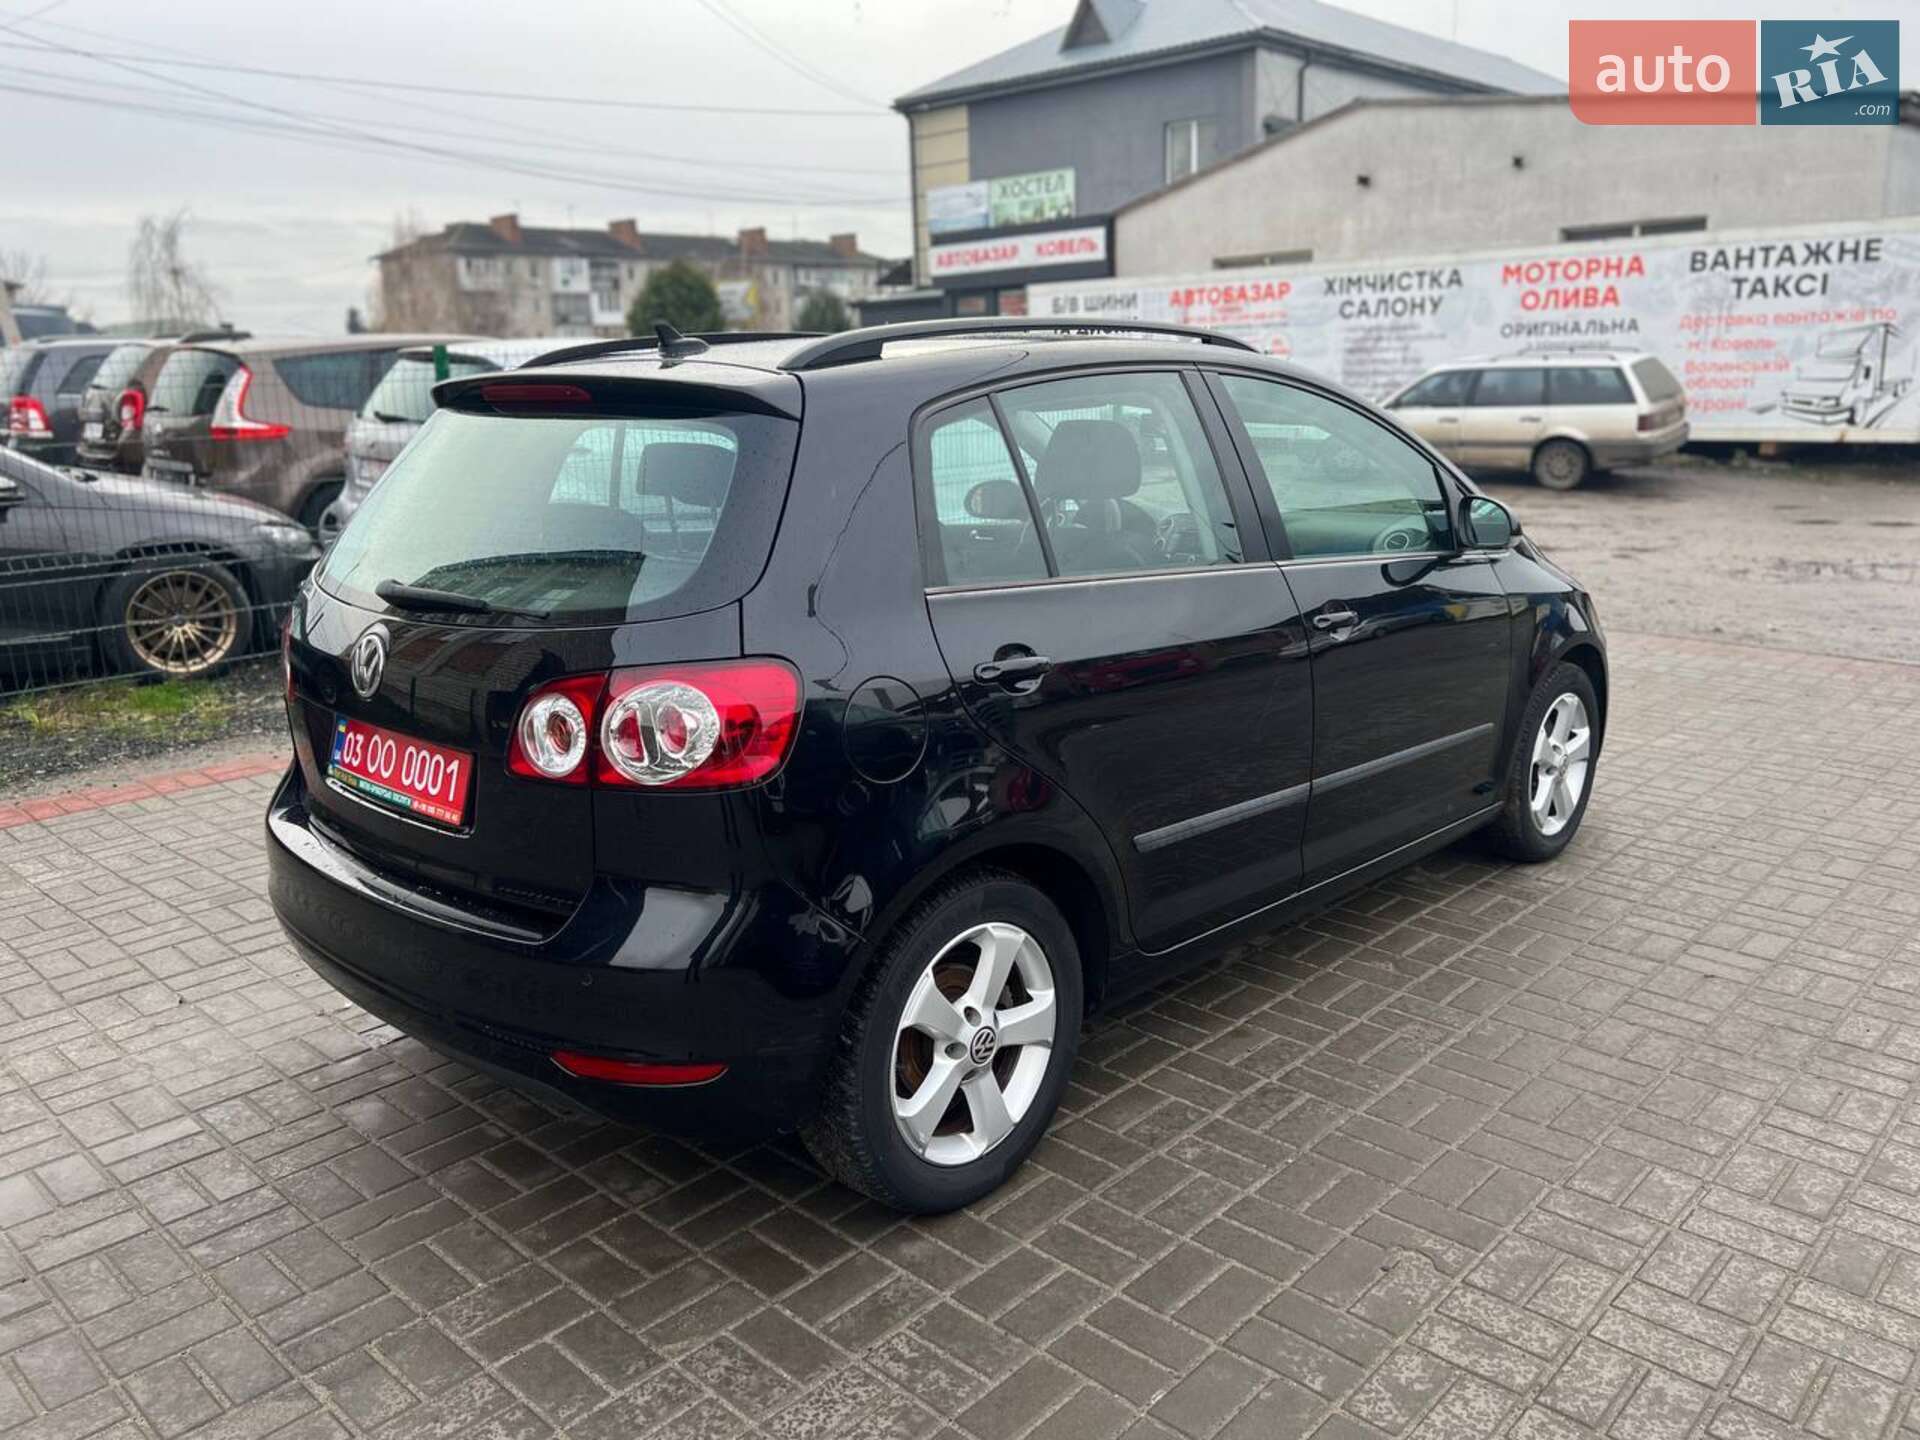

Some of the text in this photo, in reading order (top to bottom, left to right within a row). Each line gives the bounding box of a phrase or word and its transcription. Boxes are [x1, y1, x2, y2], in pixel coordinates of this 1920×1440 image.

[997, 174, 1067, 199] ХОСТЕЛ
[937, 238, 1099, 268] АВТОБАЗАР КОВЕЛЬ
[1689, 238, 1883, 273] ВАНТАЖНЕ
[1323, 269, 1464, 296] ХІМЧИСТКА
[1502, 254, 1645, 285] МОТОРНА
[1169, 281, 1292, 308] АВТОБАЗАР
[1520, 284, 1620, 312] ОЛИВА
[1732, 273, 1829, 300] ТАКСІ
[1083, 291, 1138, 311] ШИНИ
[1338, 296, 1444, 320] САЛОНУ
[1500, 317, 1640, 339] ОРИГІНАЛЬНА
[343, 731, 364, 767] 03
[401, 745, 460, 802] 0001
